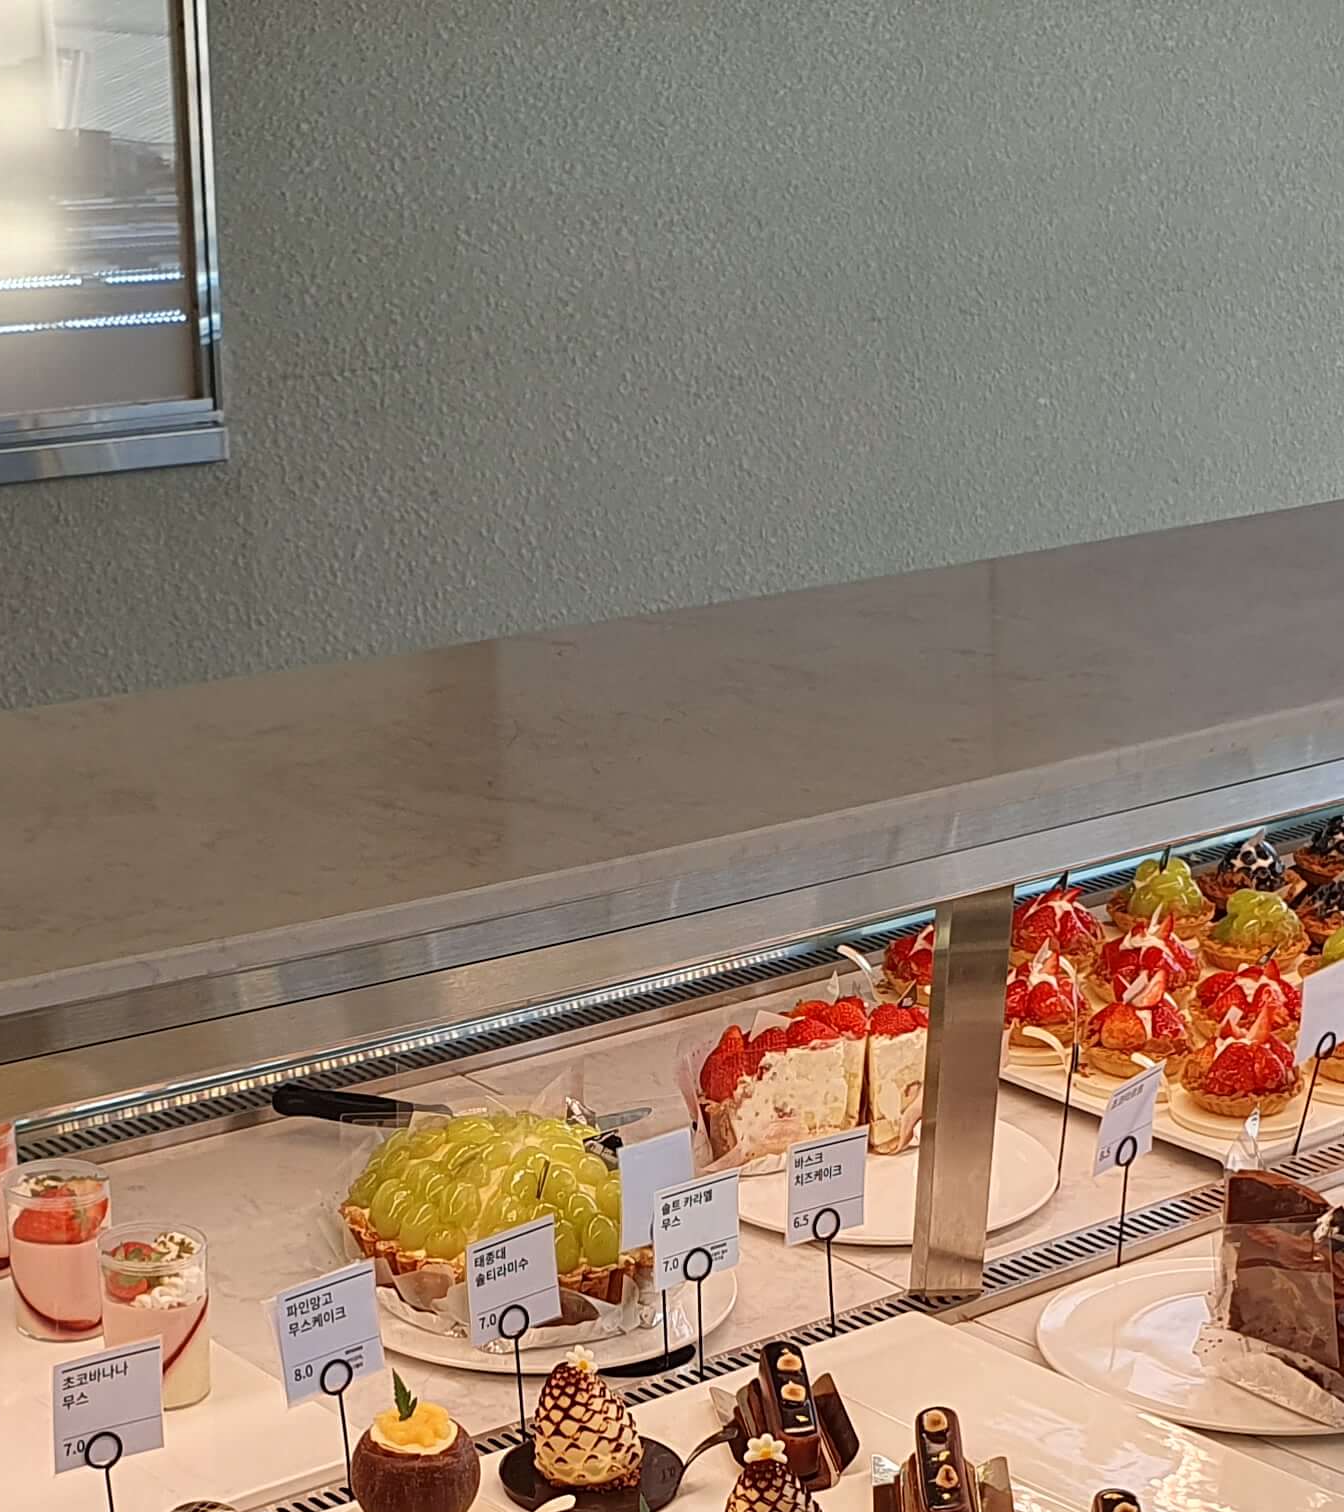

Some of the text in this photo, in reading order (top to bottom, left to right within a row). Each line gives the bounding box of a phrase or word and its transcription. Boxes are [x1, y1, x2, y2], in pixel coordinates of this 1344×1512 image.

[794, 1152, 824, 1169] 바스크
[794, 1164, 842, 1187] 치즈케이크
[661, 1216, 681, 1231] 무스
[793, 1214, 809, 1229] 6.5
[663, 1258, 679, 1273] 7.0
[287, 1292, 333, 1318] 파인망고
[289, 1306, 347, 1336] 무스케이크
[479, 1313, 496, 1330] 7.0
[62, 1361, 128, 1391] 초코바나나
[294, 1364, 314, 1382] 8.0
[62, 1392, 89, 1411] 무스
[63, 1439, 86, 1457] 7.0
